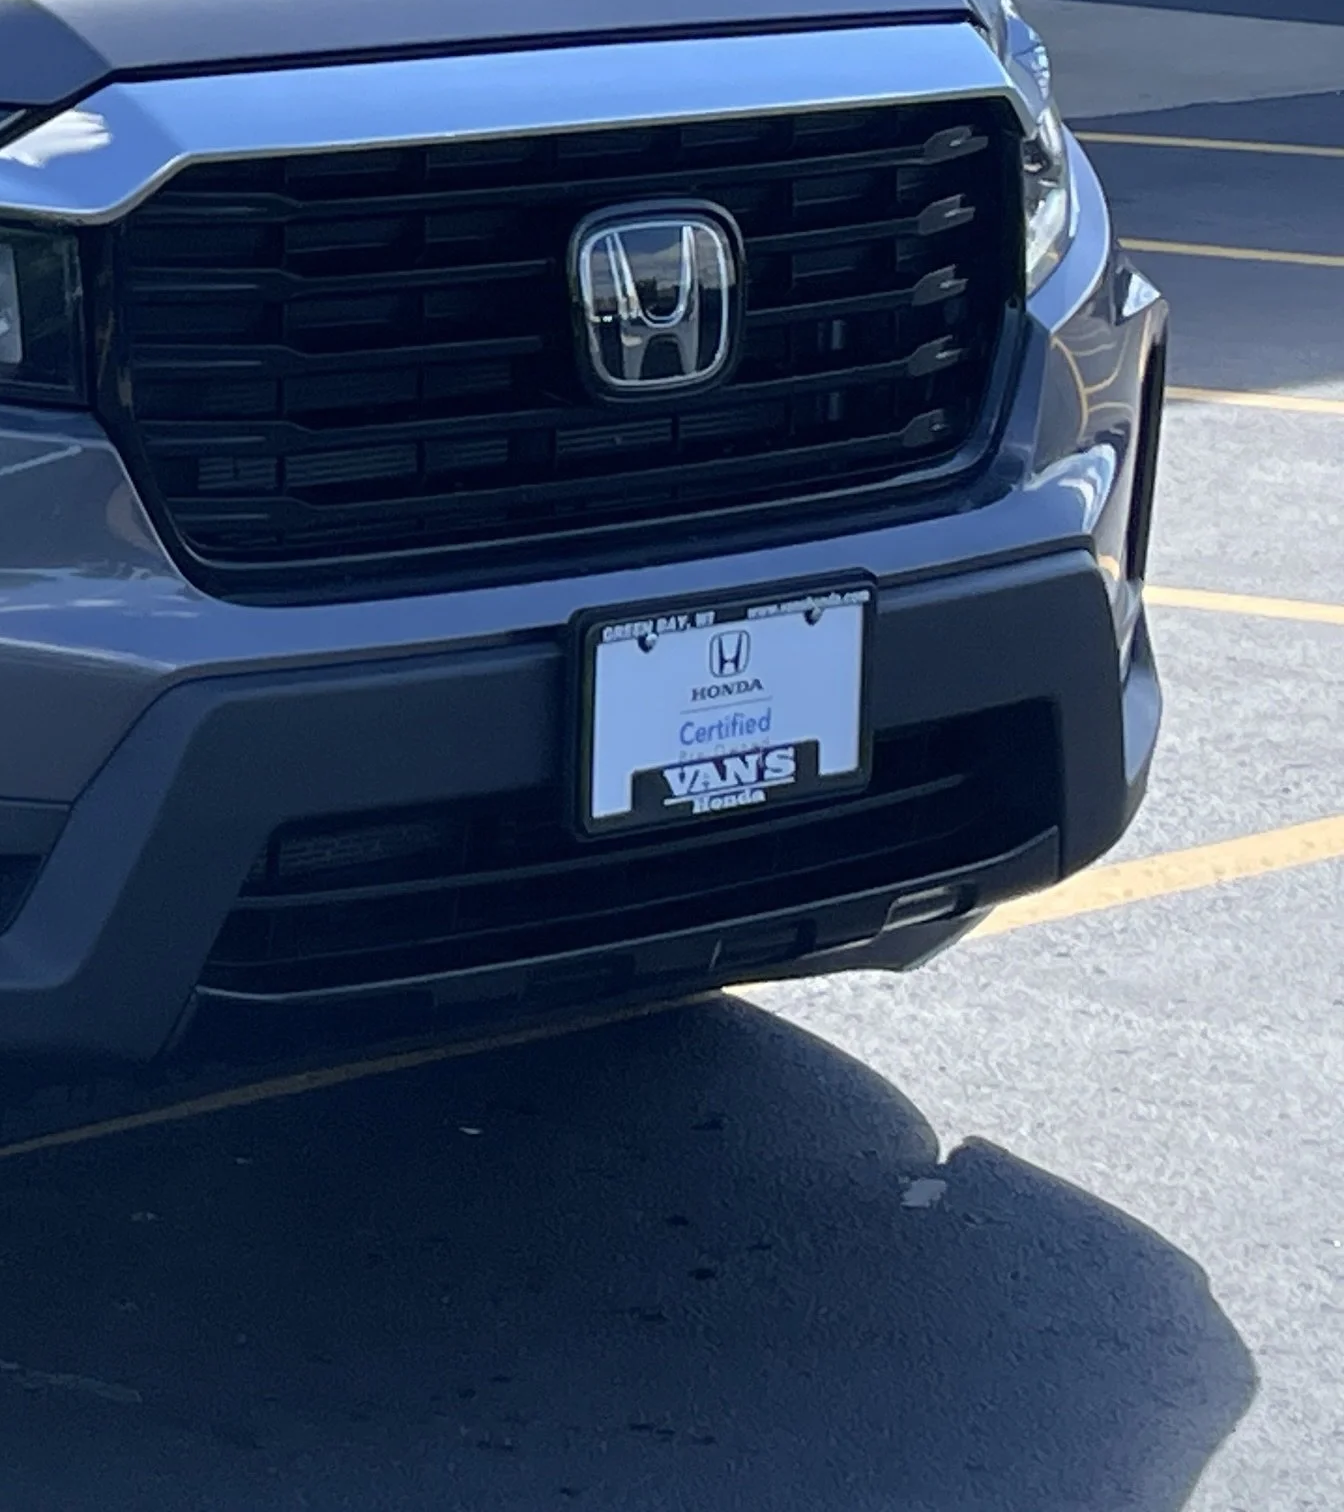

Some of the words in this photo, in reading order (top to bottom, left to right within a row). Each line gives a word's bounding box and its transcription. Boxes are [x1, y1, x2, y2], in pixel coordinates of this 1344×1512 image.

[691, 678, 764, 701] HONDA
[679, 707, 772, 746] Certified
[692, 788, 766, 814] Honda
